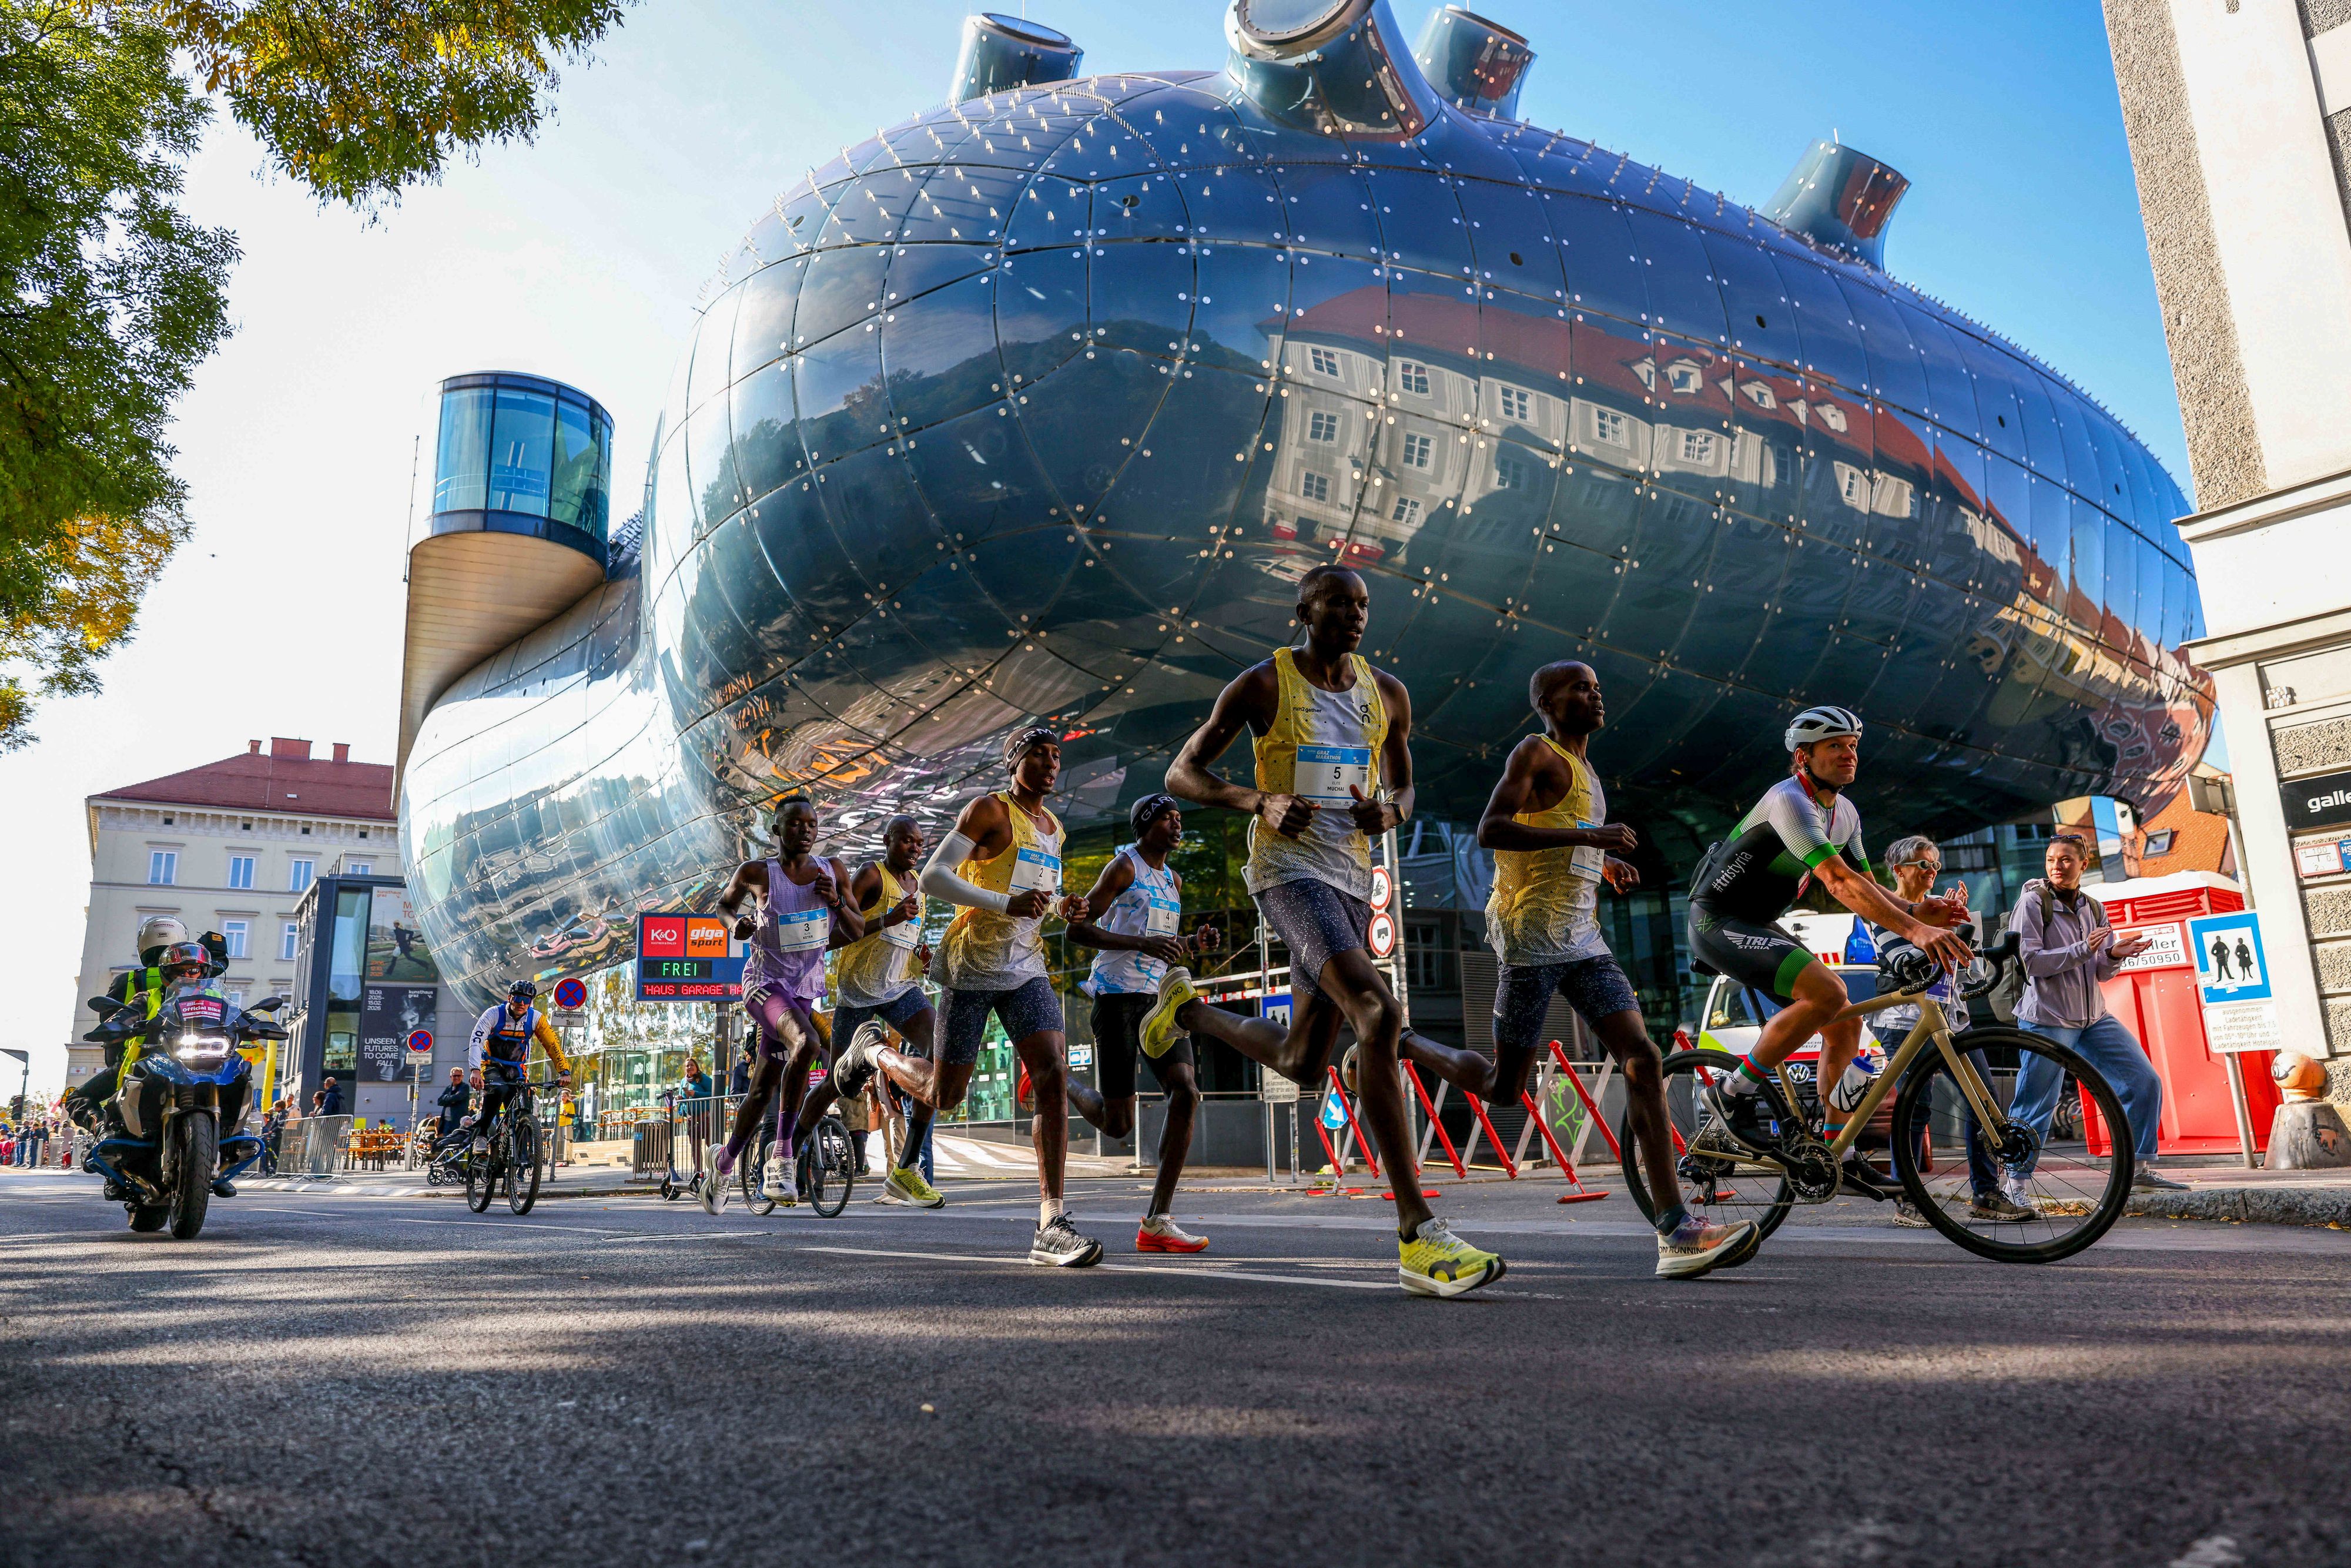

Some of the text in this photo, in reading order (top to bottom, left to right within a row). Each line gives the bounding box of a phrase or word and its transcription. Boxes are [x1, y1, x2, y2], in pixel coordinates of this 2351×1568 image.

[1333, 766, 1341, 779] 5
[2312, 846, 2327, 855] 100
[1039, 867, 1044, 877] 2
[1712, 852, 1753, 892] #tristyria
[1166, 912, 1170, 921] 4
[804, 923, 810, 932] 3
[690, 927, 724, 940] giga
[691, 939, 723, 947] sport
[1746, 936, 1769, 946] TRI
[662, 962, 697, 976] FREI
[681, 985, 723, 995] GARAGE
[2222, 1006, 2263, 1016] ausgenommen
[2225, 1015, 2262, 1023] Ladetätigkeit
[2223, 1023, 2256, 1031] Fahrzeugen
[2214, 1040, 2252, 1049] Ladetätigkeit
[1669, 1246, 1708, 1255] RUNNING
